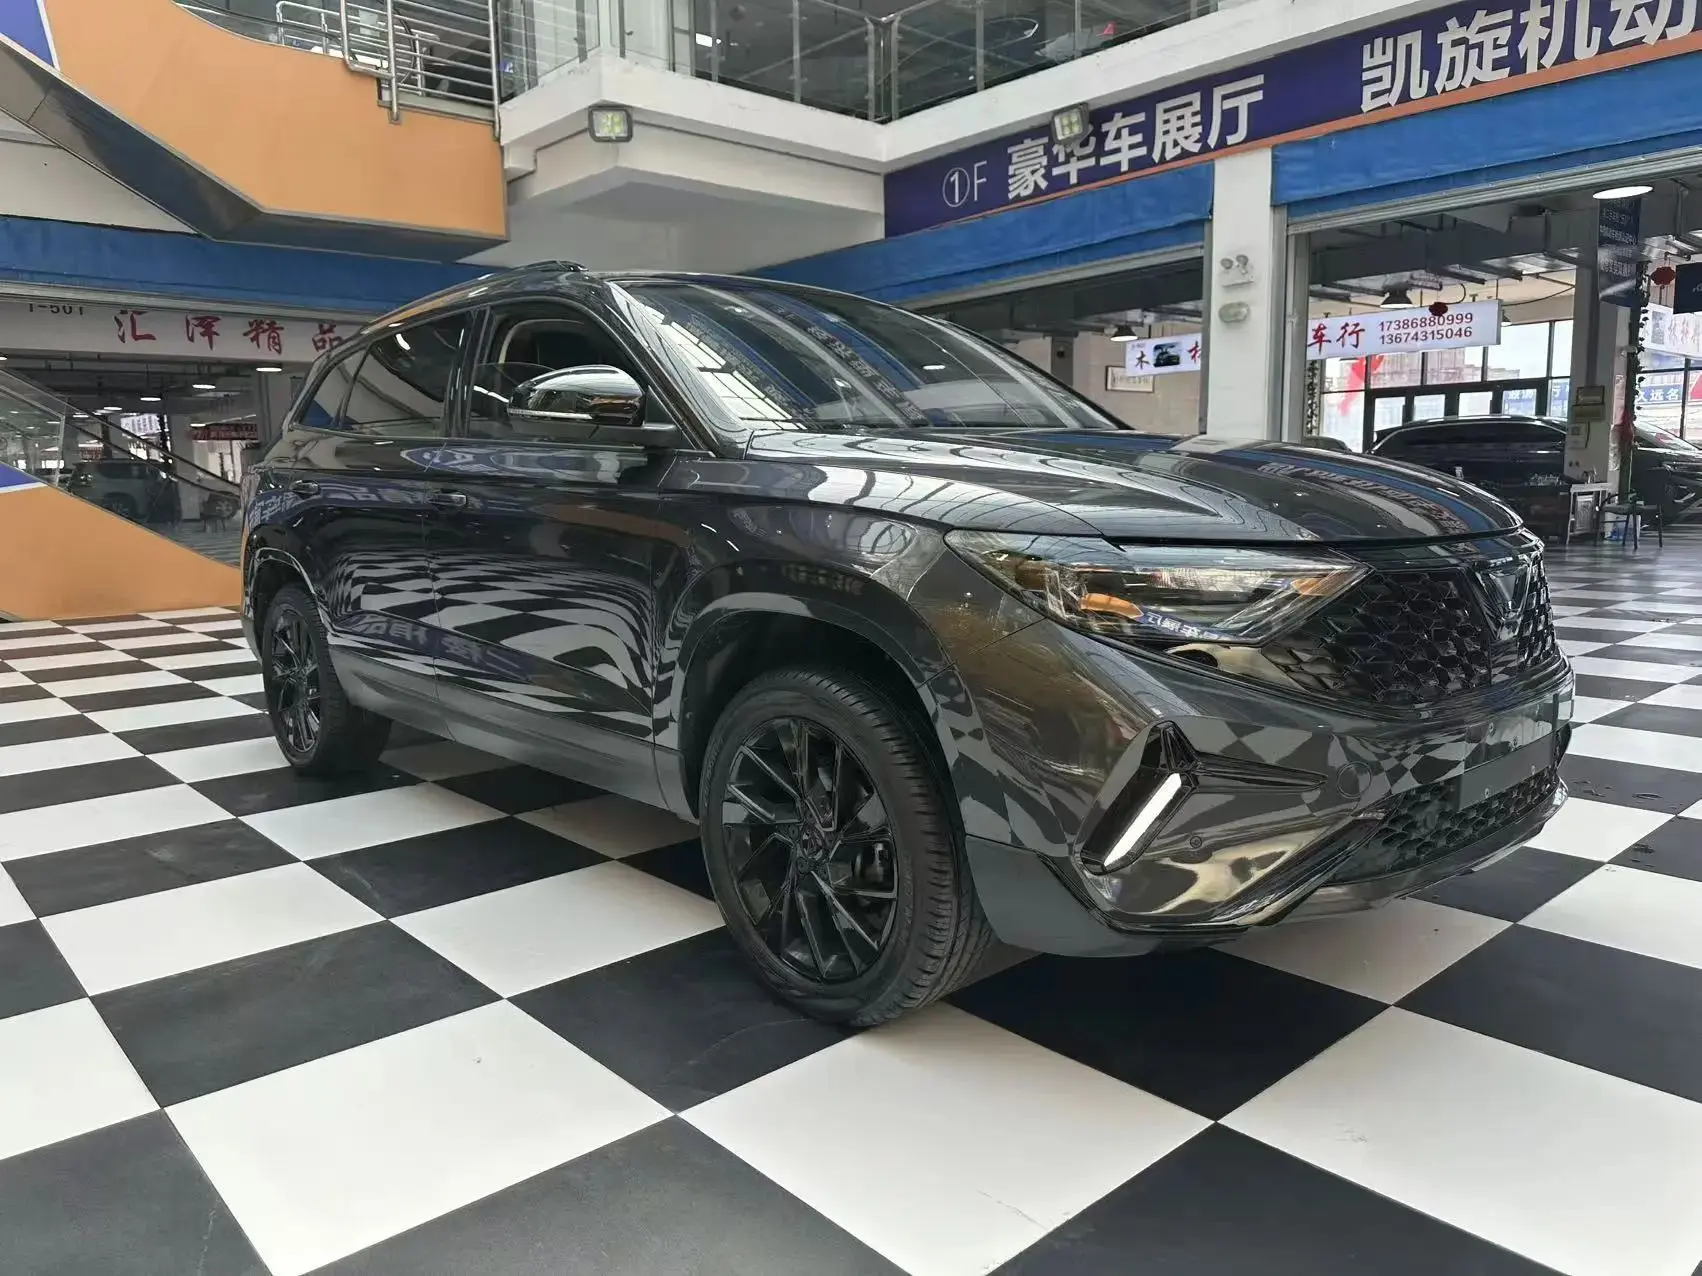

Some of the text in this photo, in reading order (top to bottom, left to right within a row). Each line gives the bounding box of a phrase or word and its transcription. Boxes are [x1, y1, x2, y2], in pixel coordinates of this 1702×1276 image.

[1007, 74, 1265, 200] 豪华车展厅
[1379, 312, 1473, 332] 17386880999
[1307, 322, 1365, 354] 车行
[1379, 326, 1473, 345] 13674315046
